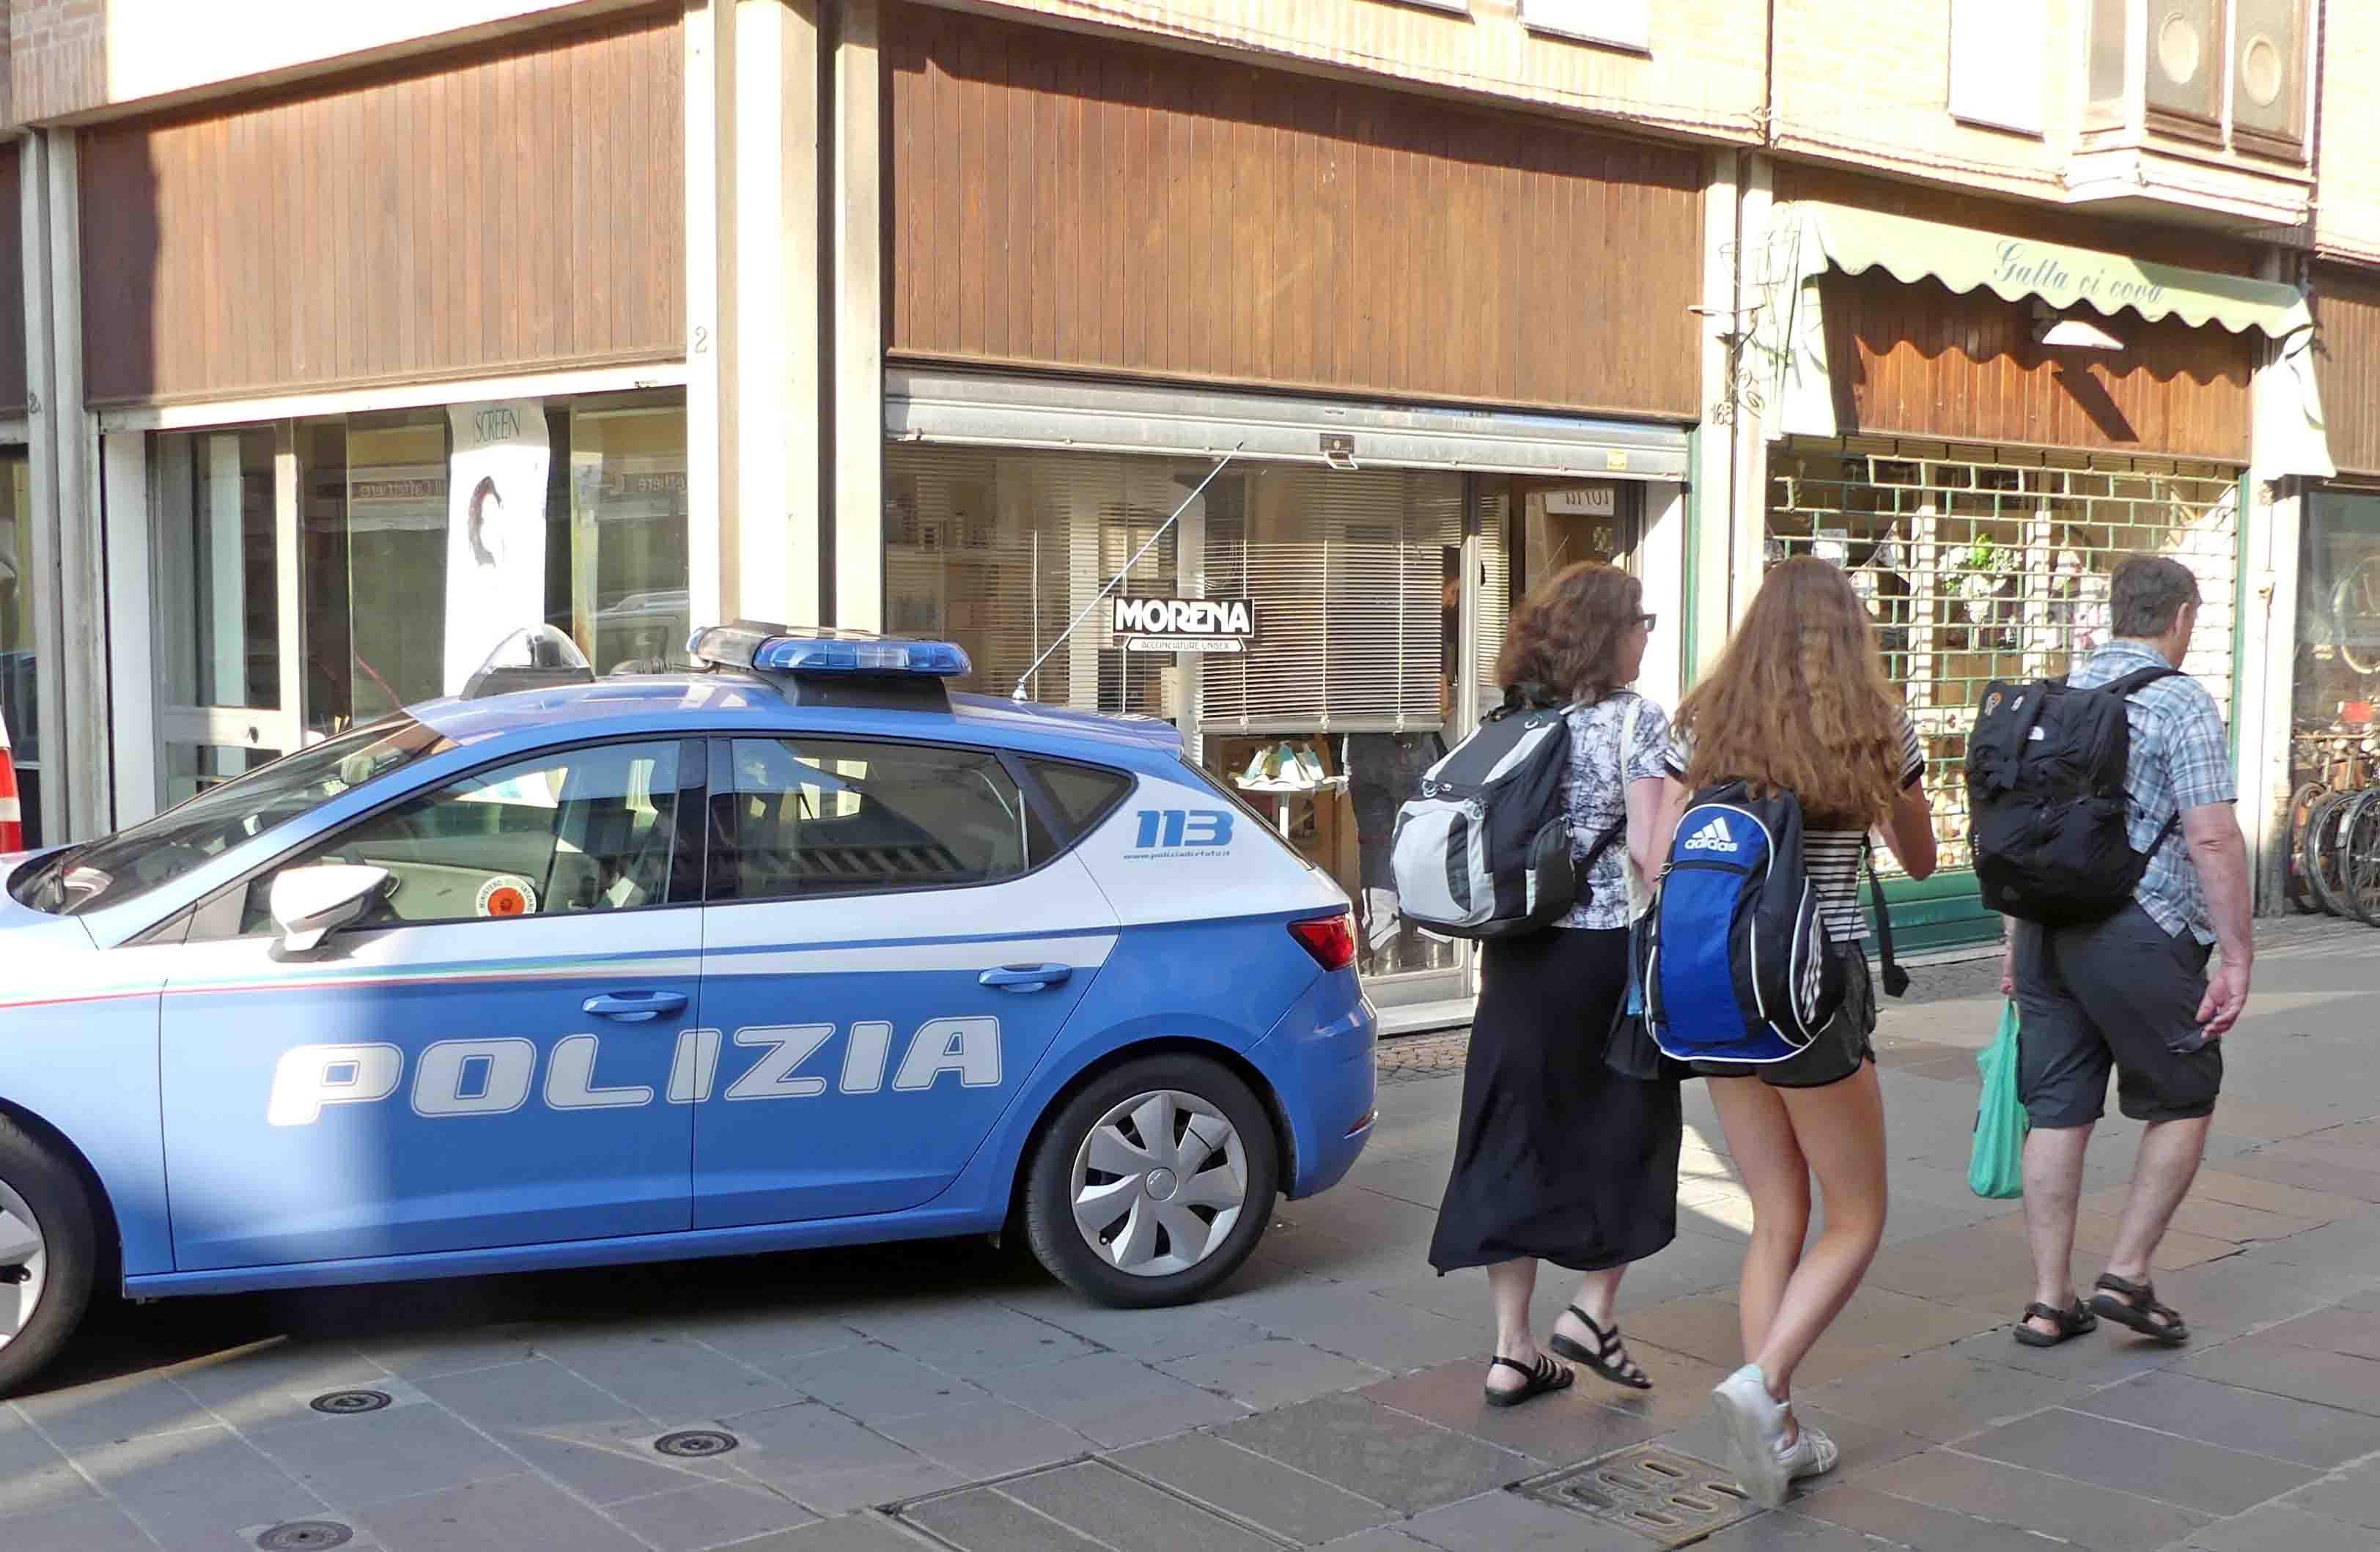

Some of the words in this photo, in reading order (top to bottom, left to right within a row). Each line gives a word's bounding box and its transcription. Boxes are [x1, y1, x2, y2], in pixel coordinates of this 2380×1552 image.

[2079, 267, 2105, 295] ci
[694, 325, 708, 353] 2
[1711, 403, 1734, 426] 163
[1116, 599, 1250, 632] MORENA
[1136, 810, 1234, 848] 113
[1684, 836, 1737, 852] adidas
[267, 1016, 1002, 1126] POLIZIA
